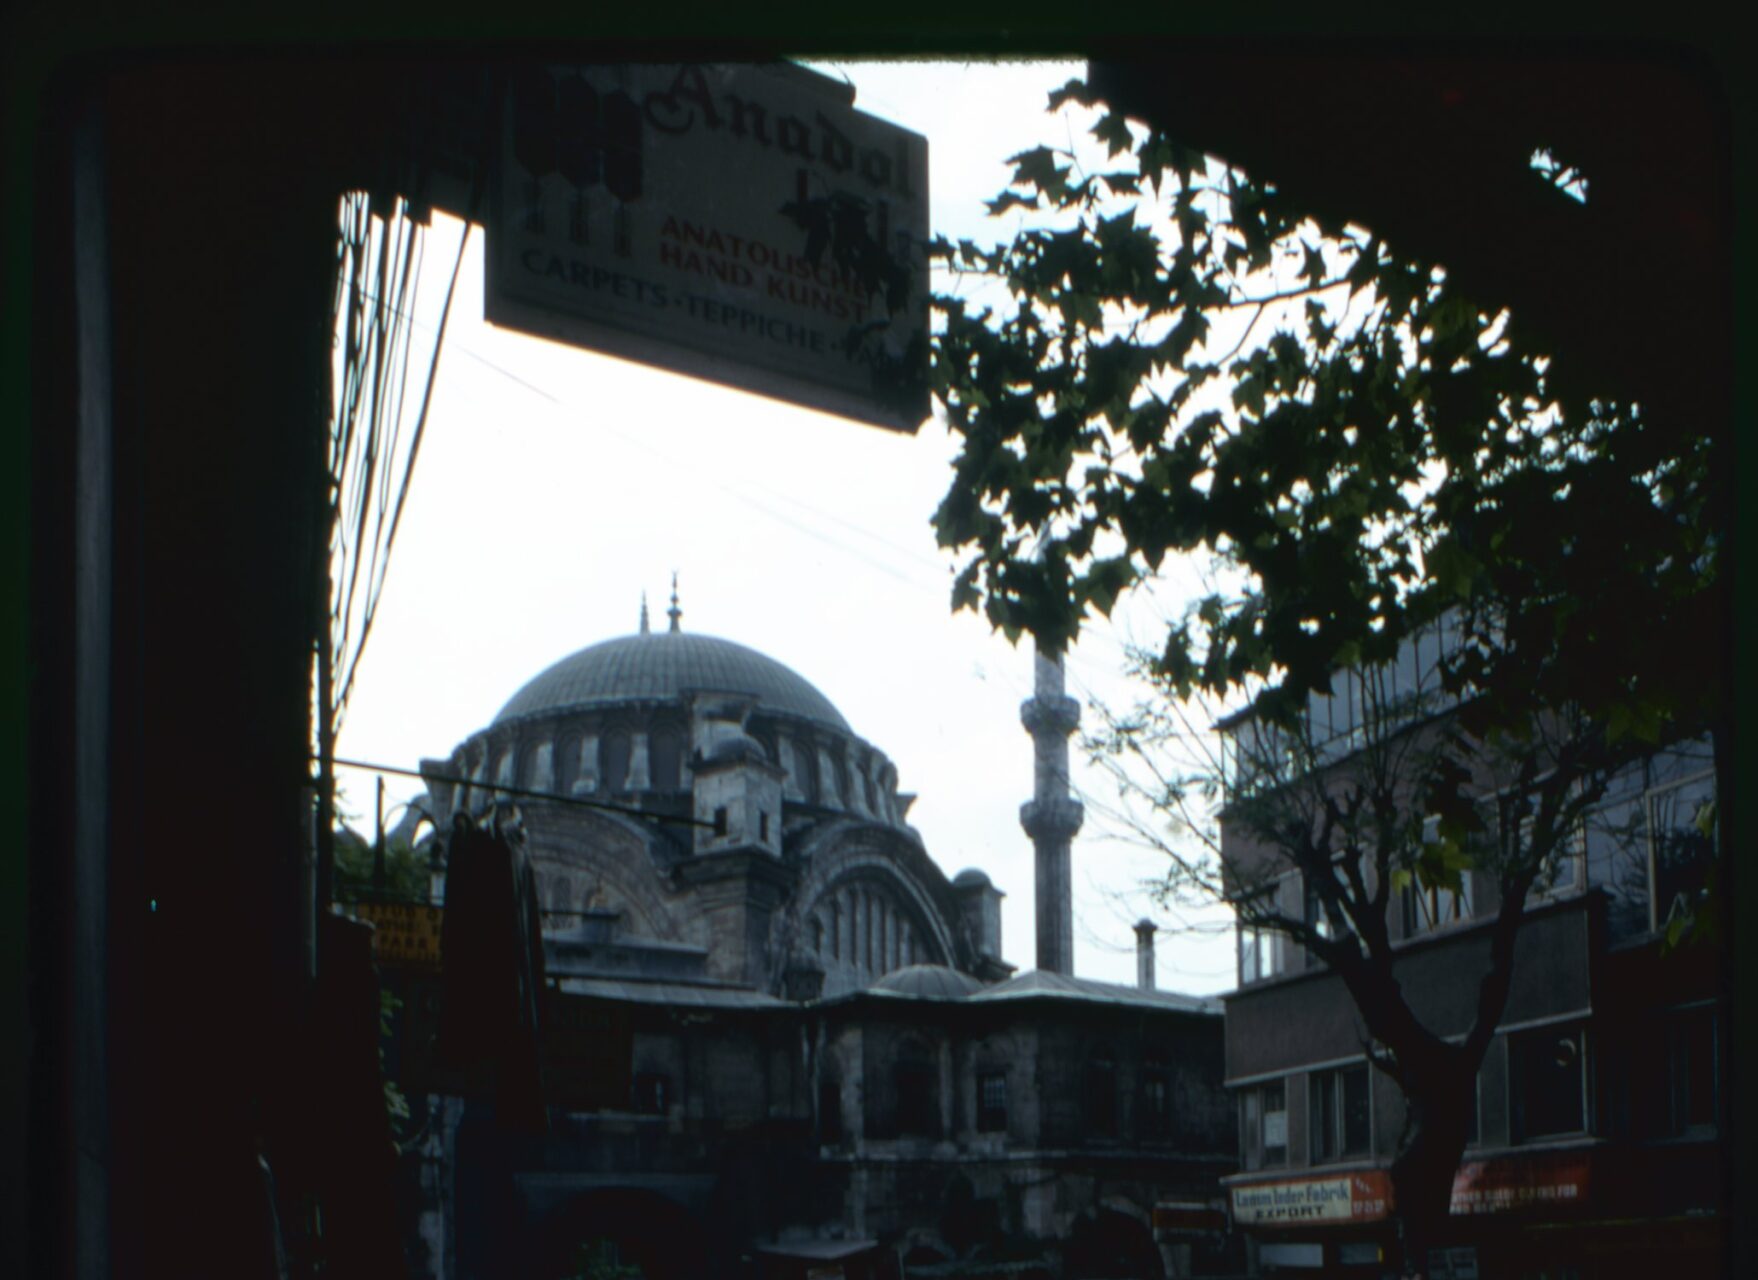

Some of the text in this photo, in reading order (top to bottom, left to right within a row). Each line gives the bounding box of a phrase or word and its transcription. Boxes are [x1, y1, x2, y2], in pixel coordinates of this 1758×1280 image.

[643, 59, 914, 198] Anadol
[521, 247, 826, 354] CARPETS TEPPICHE
[660, 241, 866, 324] HAND KUNST
[1255, 1205, 1323, 1218] EXPORT
